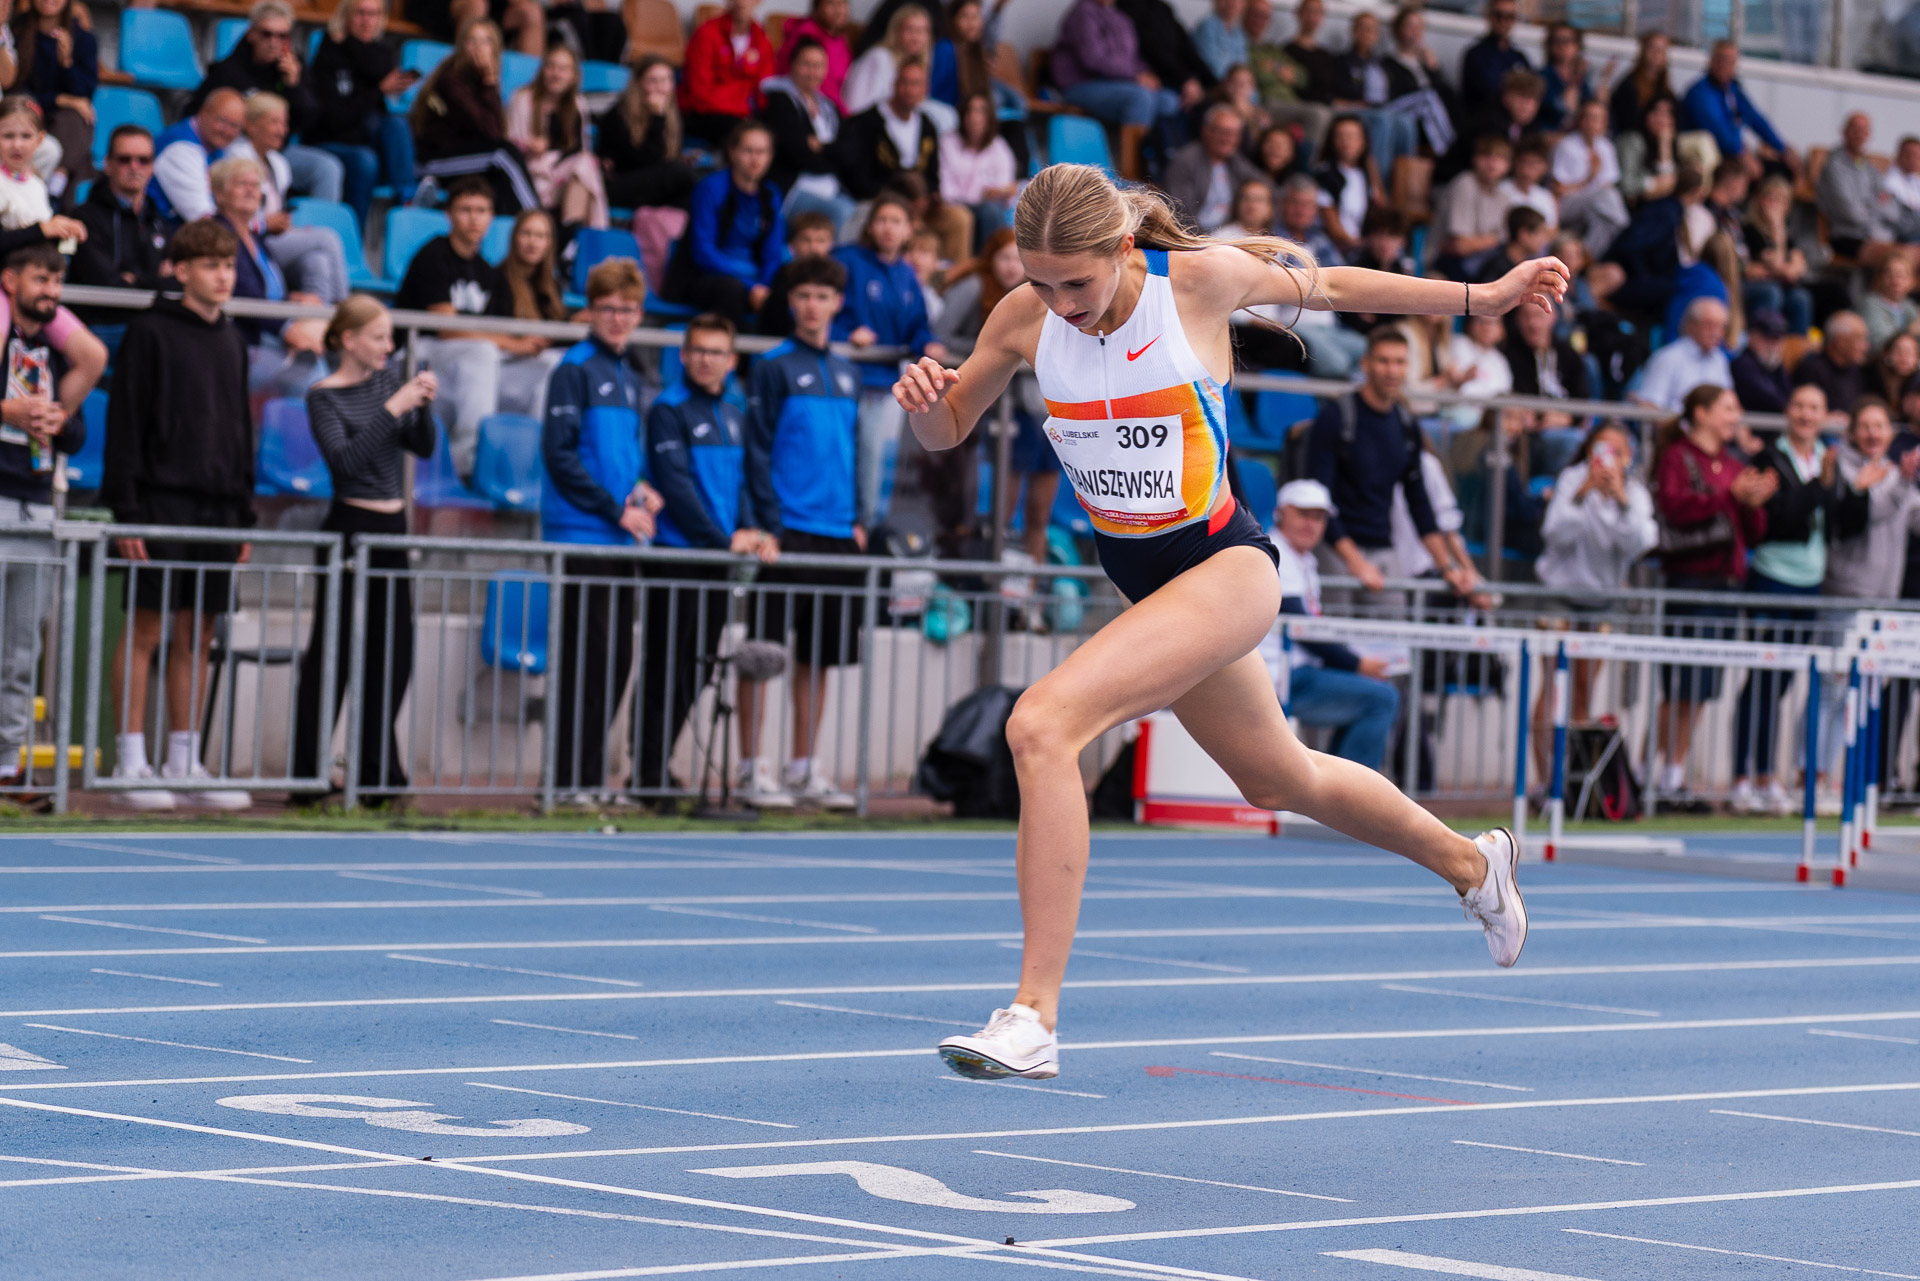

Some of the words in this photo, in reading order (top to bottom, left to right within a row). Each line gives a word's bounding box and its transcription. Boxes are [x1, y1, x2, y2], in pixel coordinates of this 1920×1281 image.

[1062, 430, 1100, 439] LUBELSKIE
[1115, 425, 1168, 449] 309
[214, 1093, 591, 1138] 3
[684, 1160, 1137, 1214] 2
